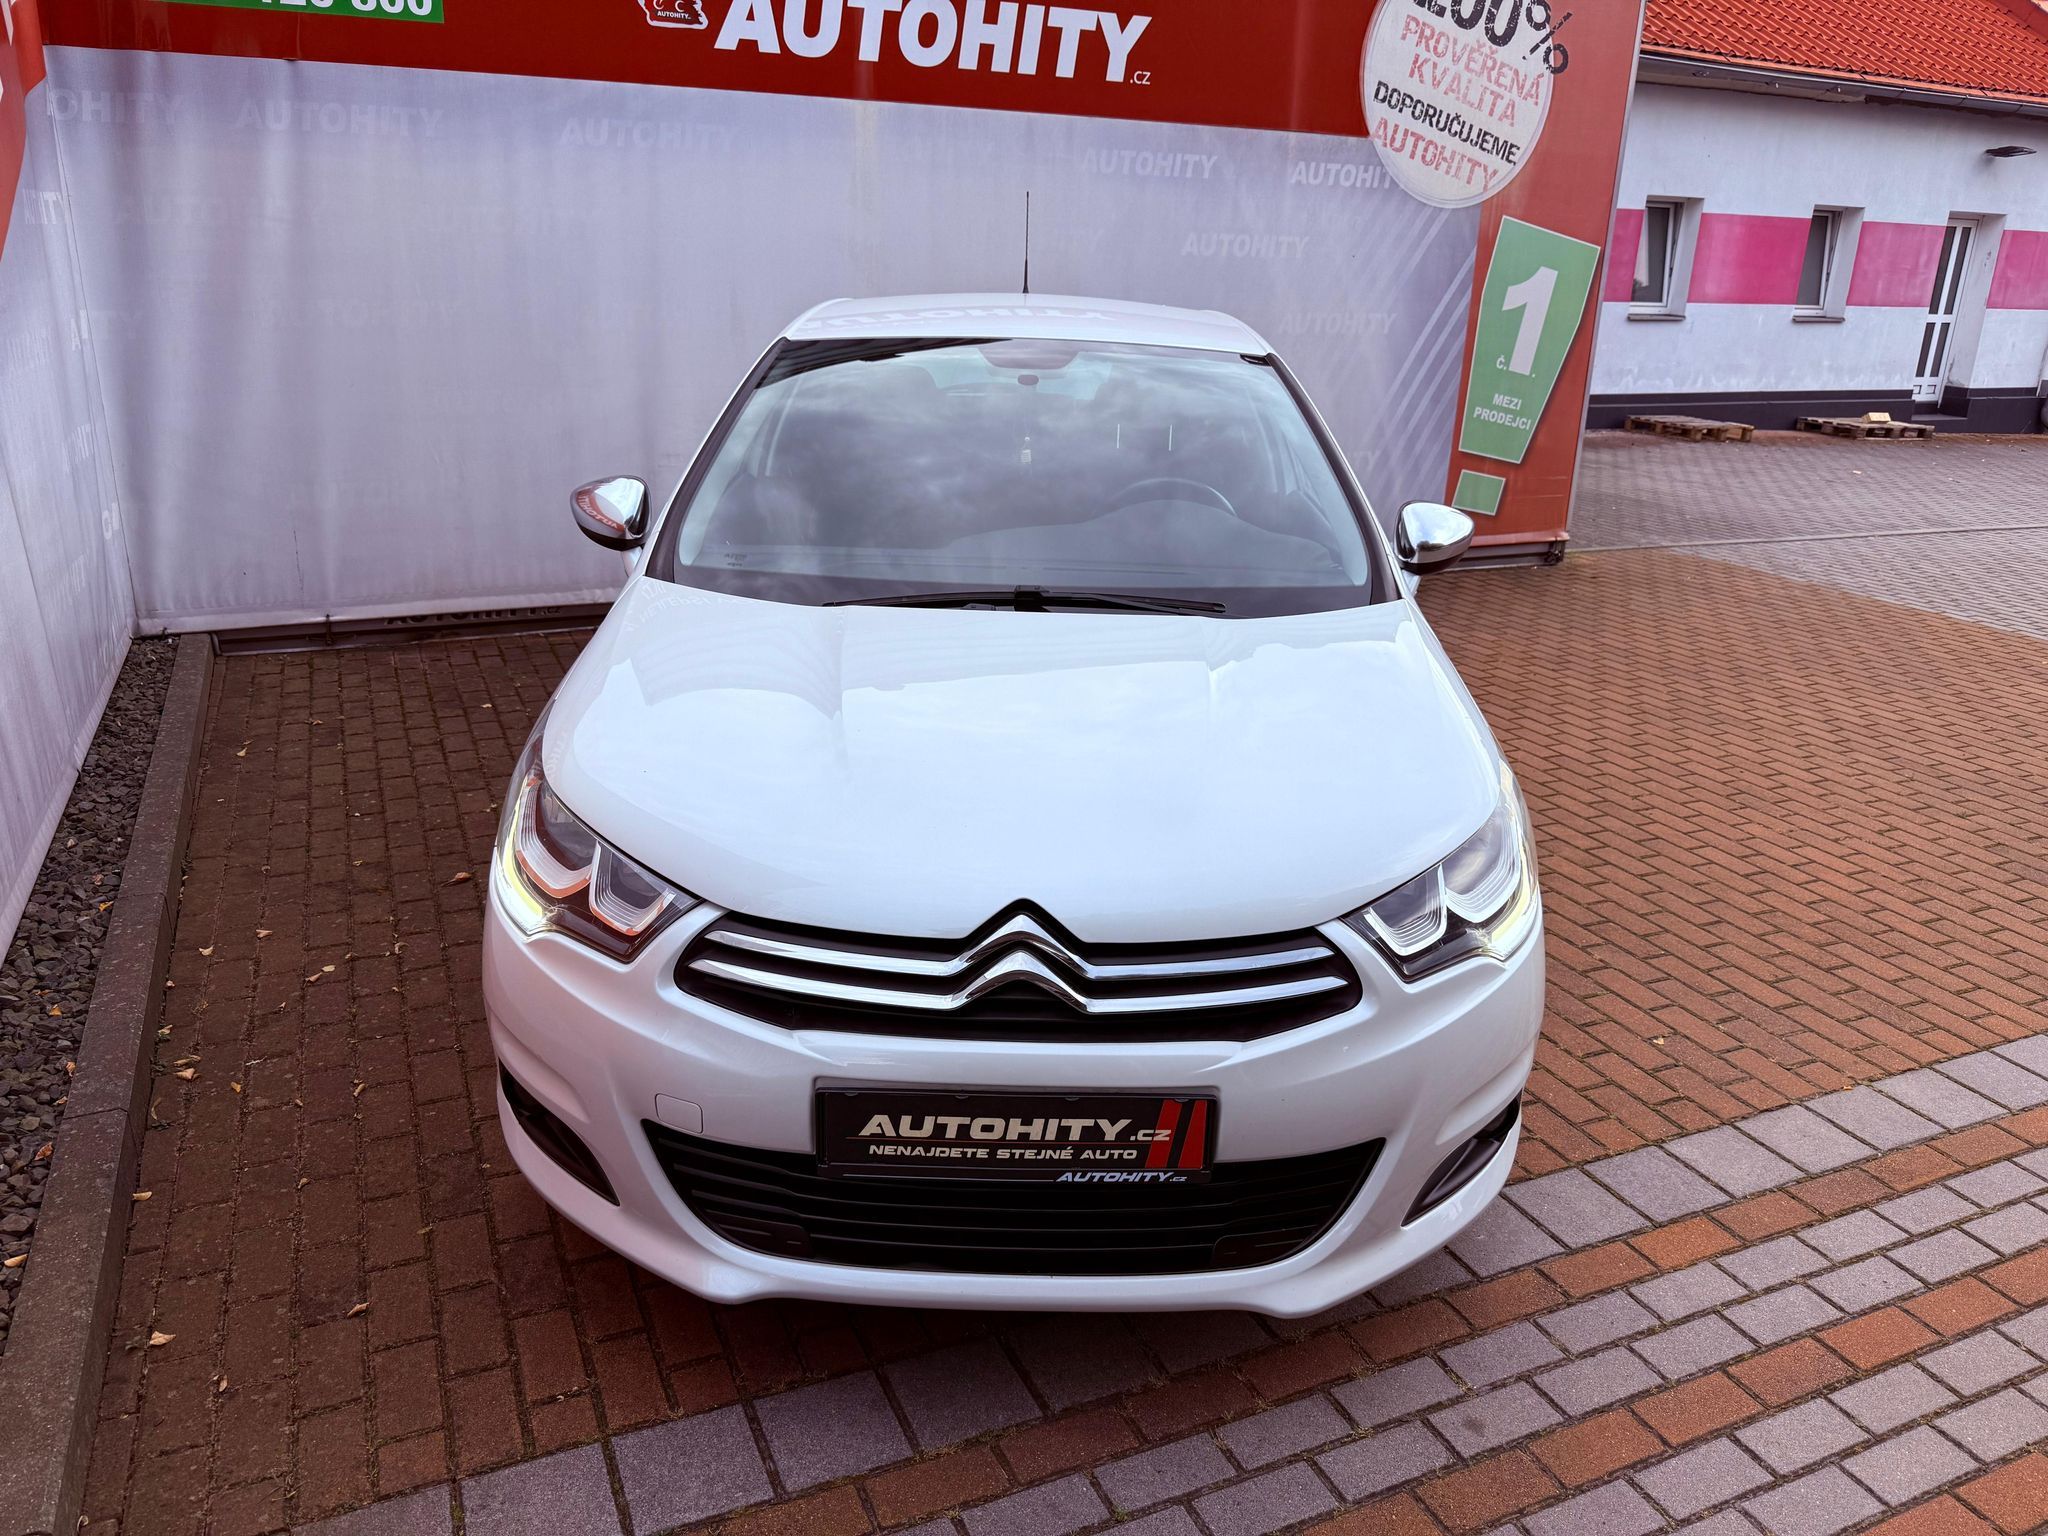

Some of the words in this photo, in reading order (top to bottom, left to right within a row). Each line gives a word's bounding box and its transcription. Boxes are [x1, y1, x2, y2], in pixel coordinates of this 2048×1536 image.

[1408, 53, 1516, 128] KVALITA
[1373, 80, 1521, 166] DOPORUČUJEME
[1082, 147, 1217, 179] AUTOHITY
[1373, 117, 1499, 193] AUTOHITY
[1290, 161, 1393, 189] AUTOHIT
[1180, 233, 1309, 259] AUTOHITY
[1493, 393, 1522, 410] MEZI
[1473, 407, 1532, 431] PRODEJCI
[869, 1145, 989, 1158] NENAJDETE
[996, 1146, 1073, 1160] STEJNÉ
[1079, 1149, 1138, 1160] AUTO
